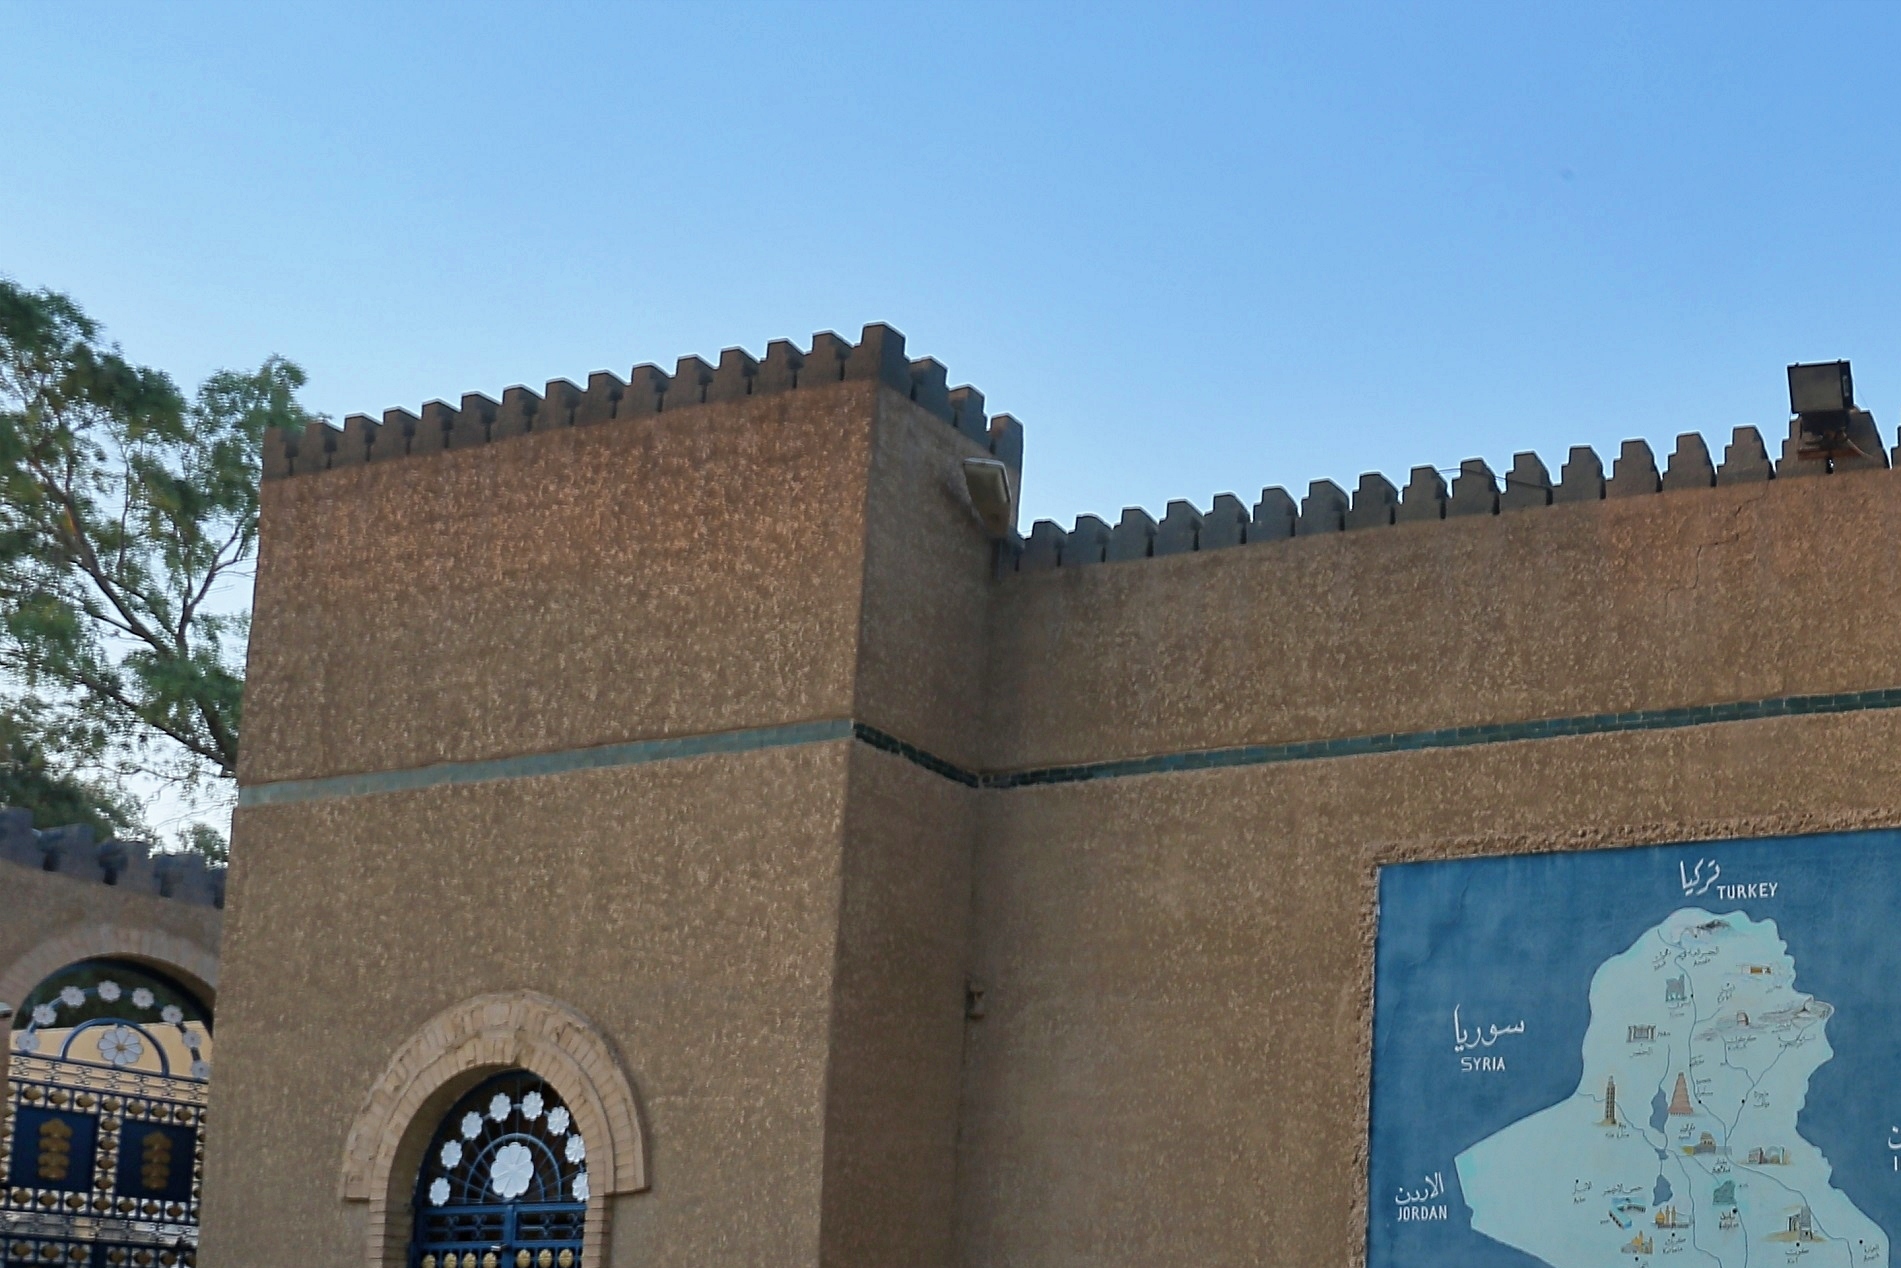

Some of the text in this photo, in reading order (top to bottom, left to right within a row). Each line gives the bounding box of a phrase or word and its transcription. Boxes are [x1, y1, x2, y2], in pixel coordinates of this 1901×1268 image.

[1680, 858, 1720, 896] تركيا
[1717, 882, 1778, 900] TURKEY
[1454, 1003, 1525, 1052] سوريا
[1460, 1057, 1506, 1072] SYRIA
[1397, 1205, 1448, 1222] JORDAN
